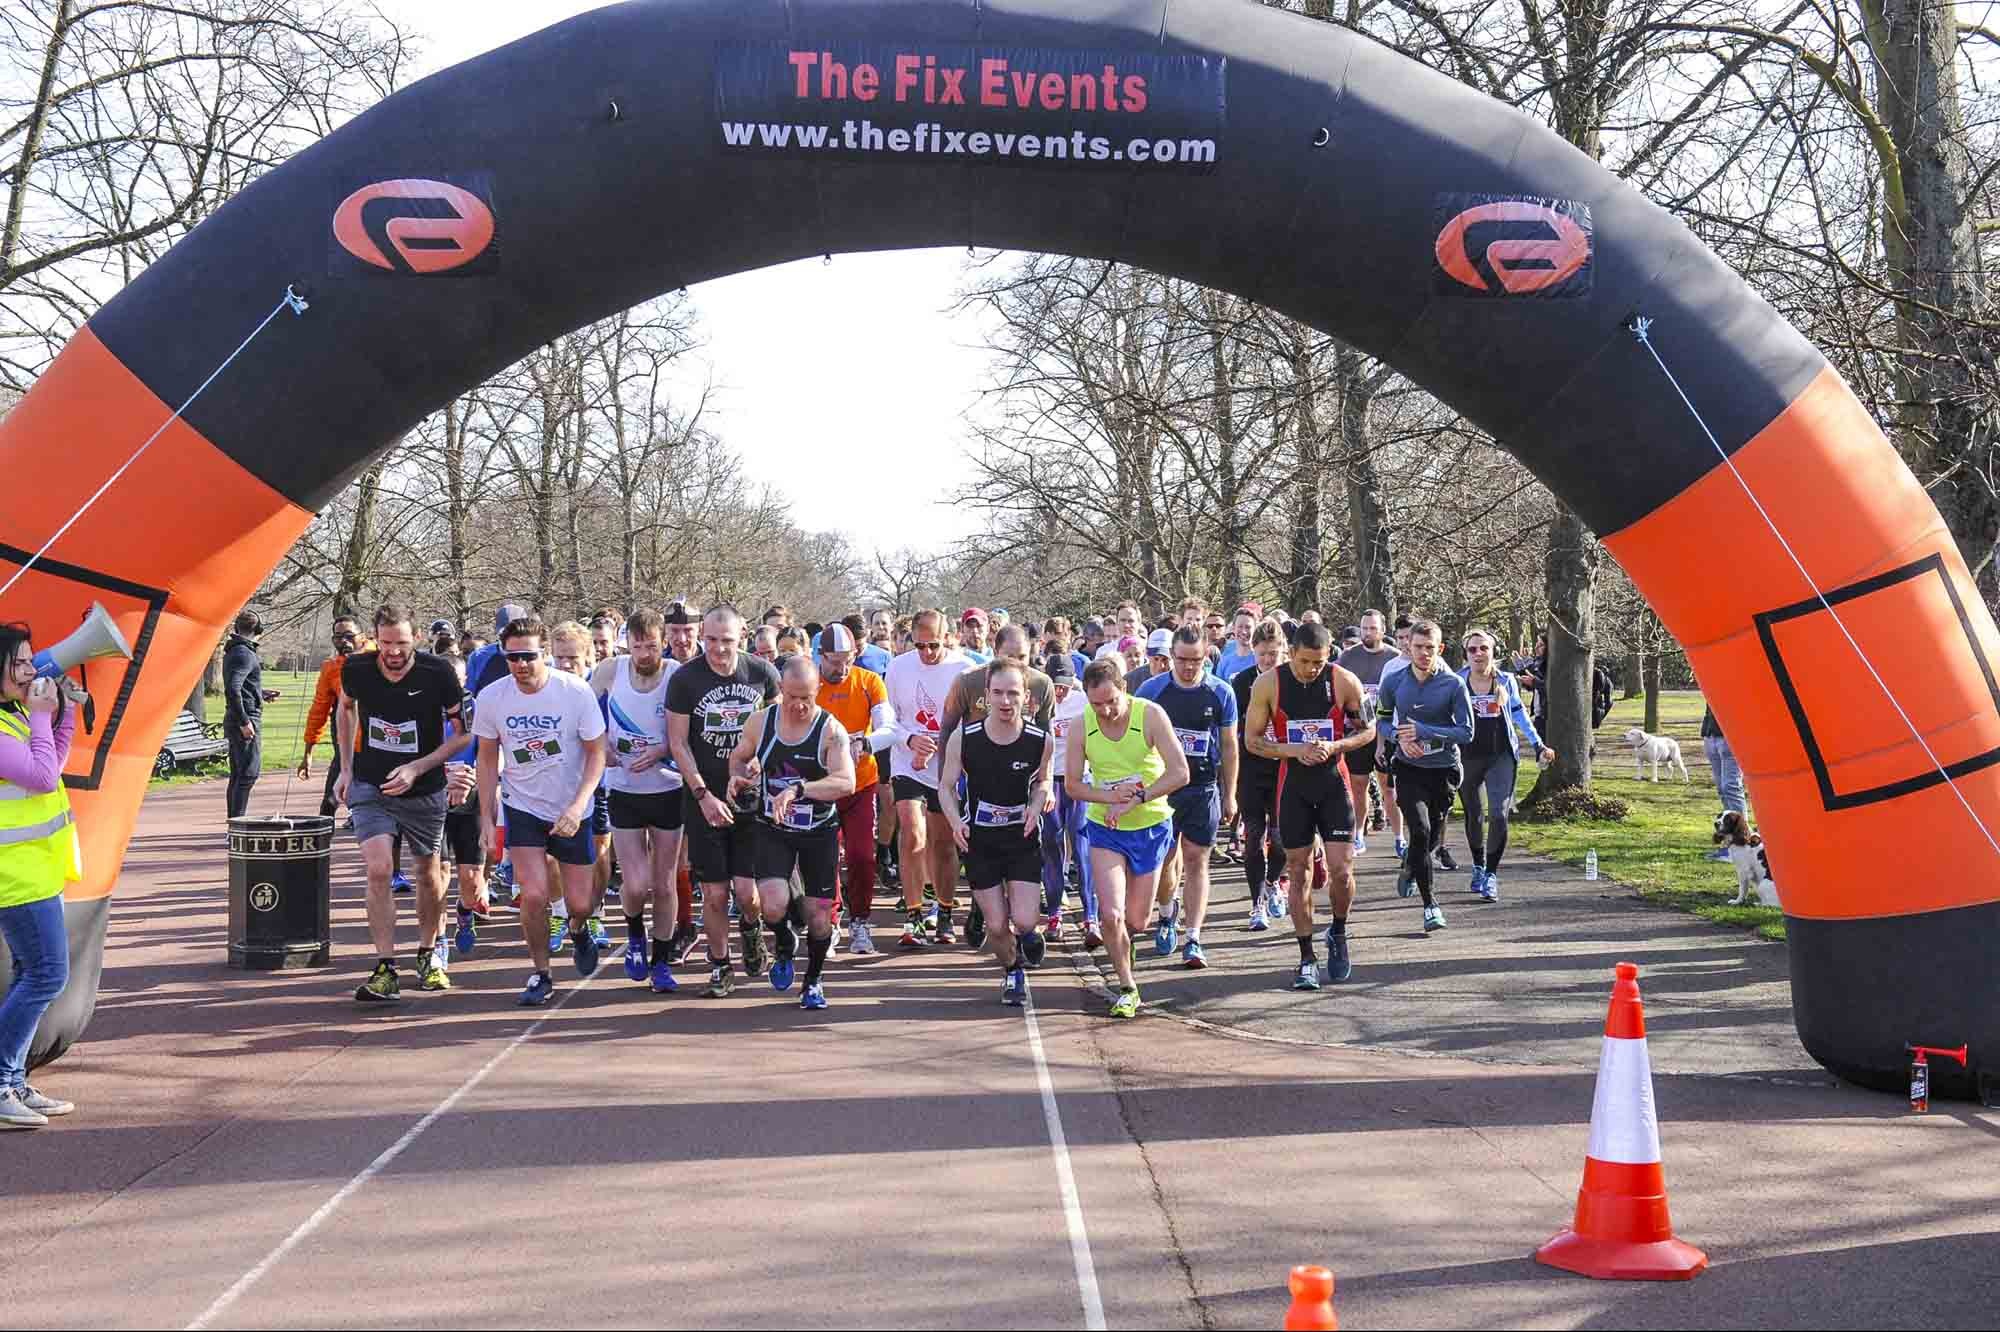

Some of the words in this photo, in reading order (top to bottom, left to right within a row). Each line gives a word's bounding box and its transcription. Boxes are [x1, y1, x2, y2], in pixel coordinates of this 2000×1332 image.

[789, 51, 880, 101] The
[895, 54, 966, 105] Fix
[980, 58, 1148, 113] Events
[721, 119, 1216, 163] www.thefixevents.com
[506, 715, 562, 729] OAKLEY
[700, 730, 726, 747] NEW
[230, 836, 317, 853] LITTER
